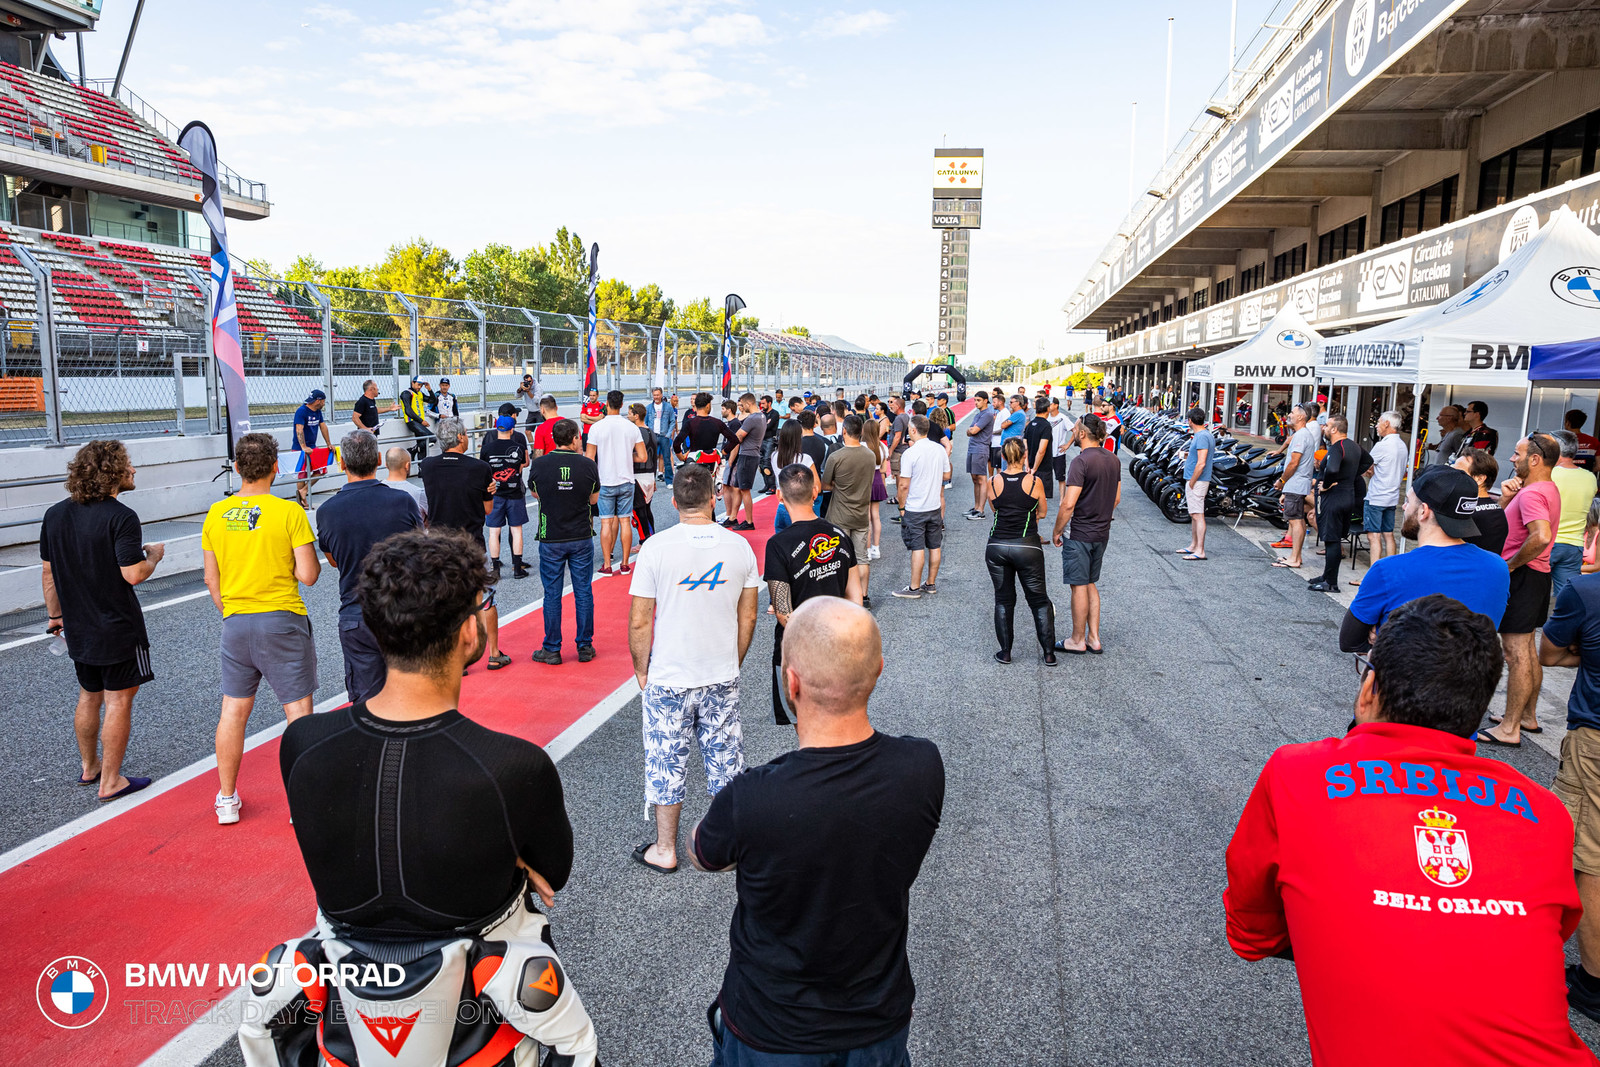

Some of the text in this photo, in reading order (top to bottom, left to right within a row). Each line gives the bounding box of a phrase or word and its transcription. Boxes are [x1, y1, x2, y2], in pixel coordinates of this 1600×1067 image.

[934, 215, 959, 225] VOLTA
[943, 232, 949, 241] 1
[942, 244, 949, 254] 2
[1414, 236, 1454, 264] Circuit de
[942, 257, 949, 266] 3
[941, 270, 948, 278] 4
[1411, 261, 1451, 285] Barcelona
[941, 282, 948, 291] 5
[1410, 283, 1450, 303] CATALUNYA
[941, 294, 947, 303] 6
[940, 307, 947, 315] 7
[940, 319, 946, 328] 8
[939, 332, 946, 340] 9
[1323, 343, 1406, 367] BMW MOTORRAD
[1234, 365, 1276, 377] BMW
[804, 536, 840, 564] ARS
[1325, 760, 1539, 824] SRBIJA
[1373, 890, 1527, 915] BELI ORLOVI
